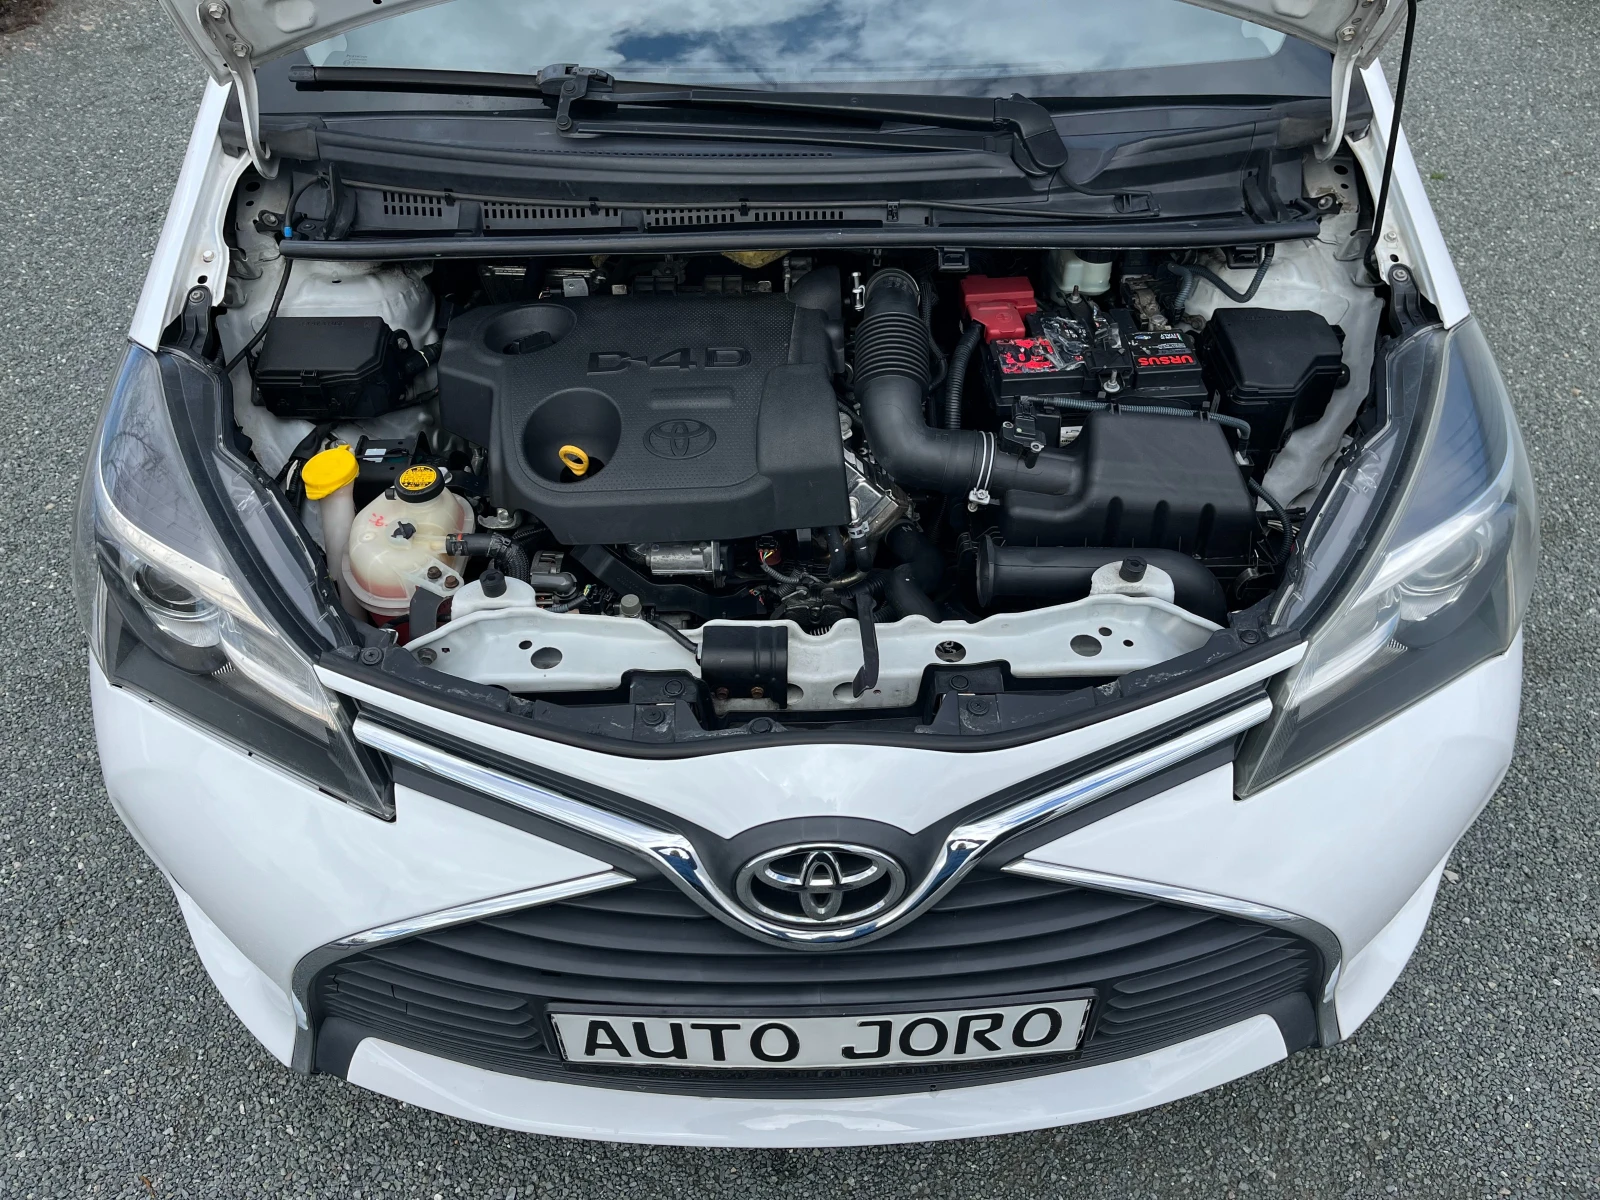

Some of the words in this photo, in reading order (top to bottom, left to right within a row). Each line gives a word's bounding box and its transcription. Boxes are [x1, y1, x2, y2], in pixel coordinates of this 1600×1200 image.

[587, 347, 752, 376] D-4D
[1137, 354, 1194, 366] URSUS
[584, 1019, 800, 1062] AUTO
[841, 1007, 1063, 1060] JORO
